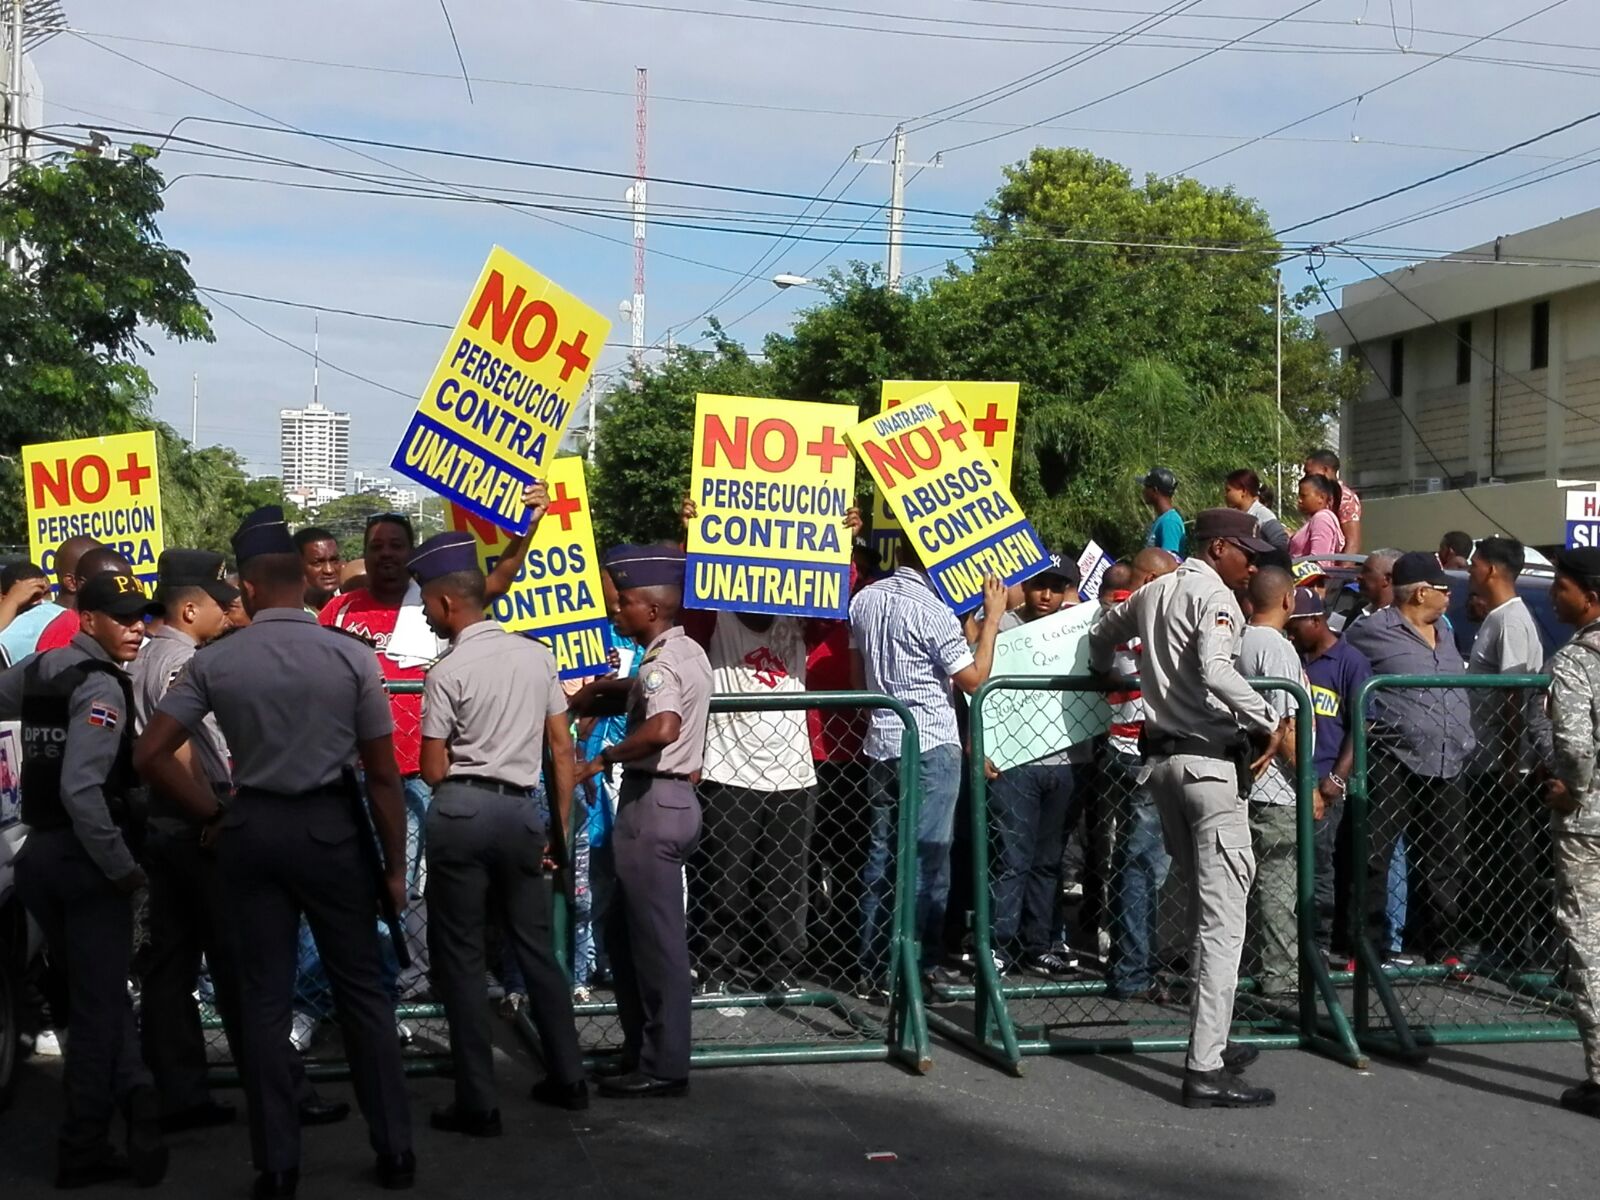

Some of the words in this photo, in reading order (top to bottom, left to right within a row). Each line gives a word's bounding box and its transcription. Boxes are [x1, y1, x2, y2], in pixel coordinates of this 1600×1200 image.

[450, 338, 570, 431] PERSECUCIÓN
[436, 378, 548, 467] CONTRA
[873, 402, 937, 437] UNATRAFIN
[405, 425, 527, 524] UNATRAFIN
[701, 478, 846, 517] PERSECUCIÓN
[901, 460, 993, 523] ABUSOS
[37, 501, 155, 544] PERSECUCIÓN
[700, 514, 841, 553] CONTRA
[918, 490, 1014, 554] CONTRA
[695, 562, 841, 609] UNATRAFIN
[938, 528, 1043, 604] UNATRAFIN
[491, 580, 596, 623] ONTRA
[25, 728, 67, 743] DPTO
